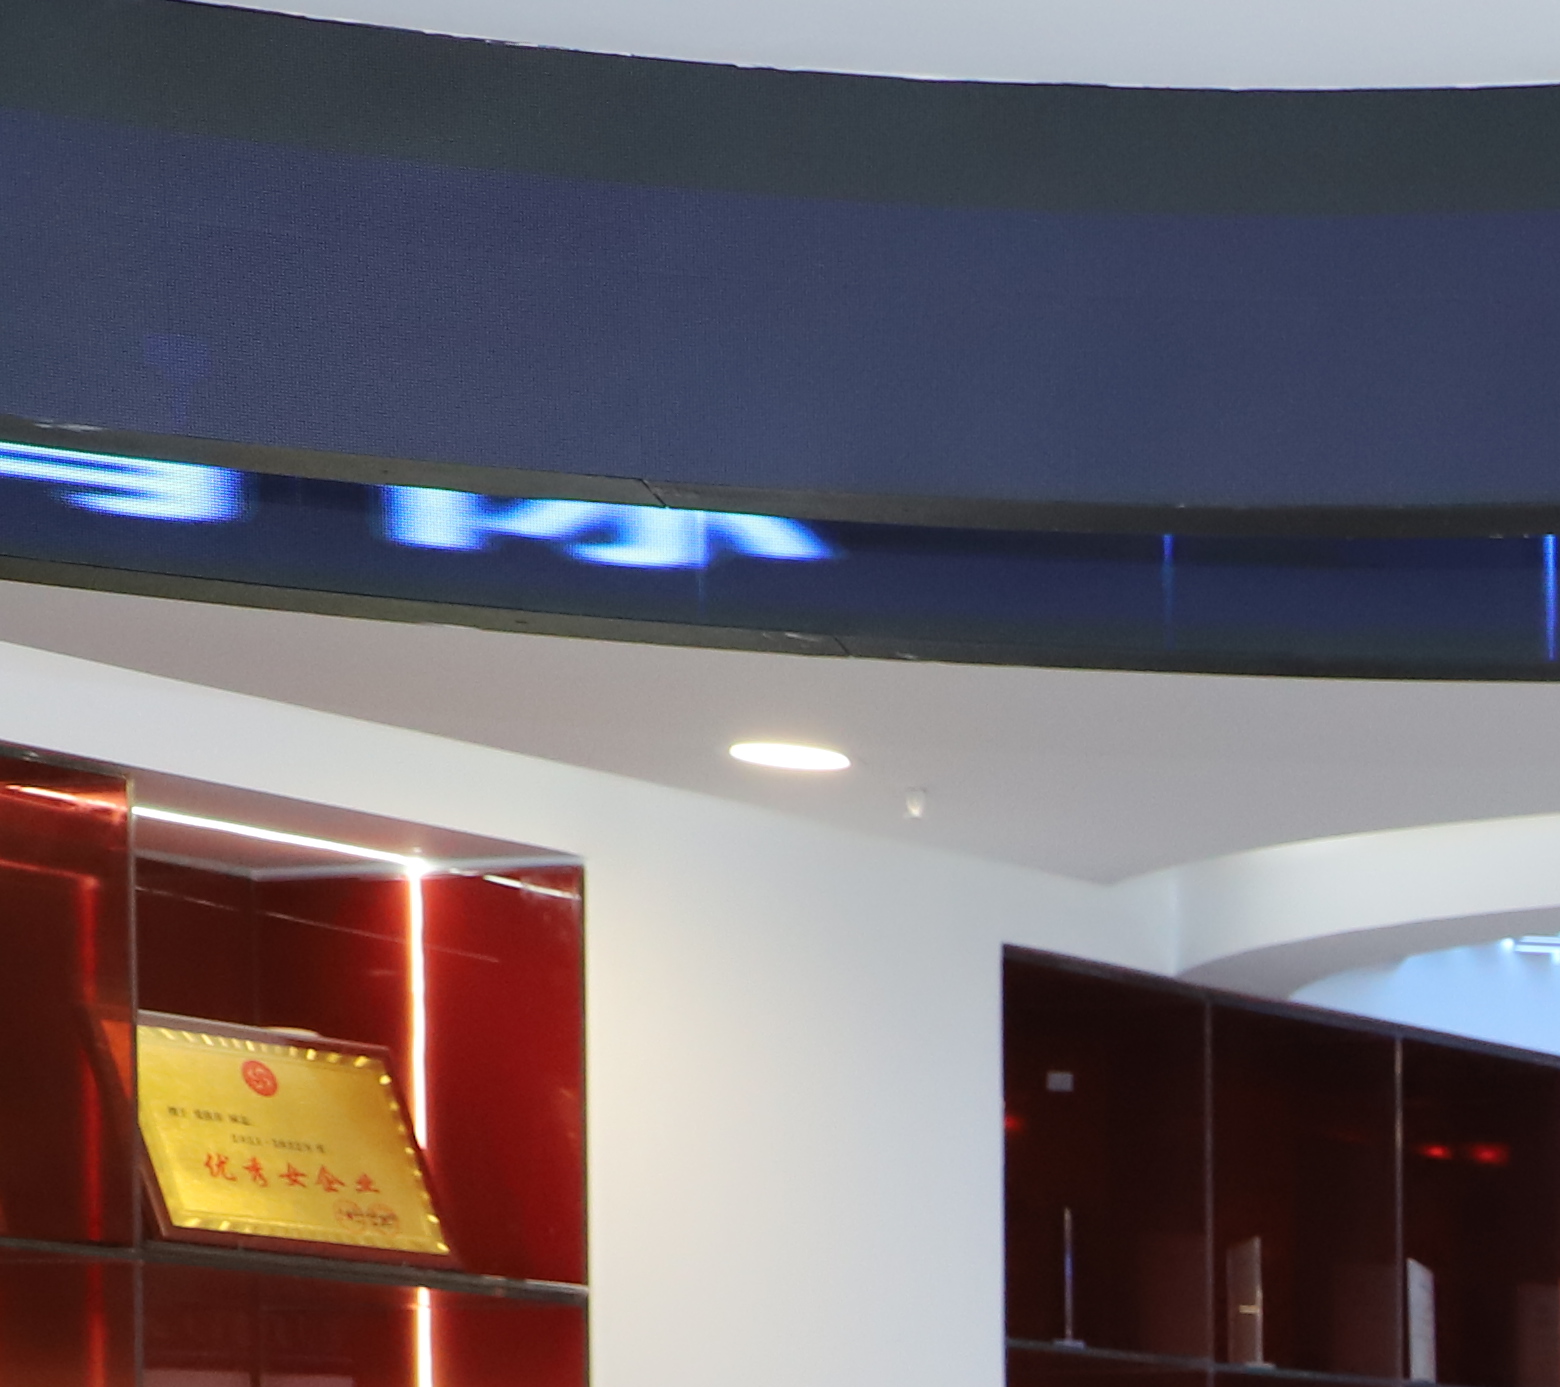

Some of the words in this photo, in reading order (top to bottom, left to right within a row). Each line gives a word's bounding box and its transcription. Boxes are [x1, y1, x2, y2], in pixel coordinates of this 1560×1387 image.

[204, 1153, 380, 1193] 优秀女企业
